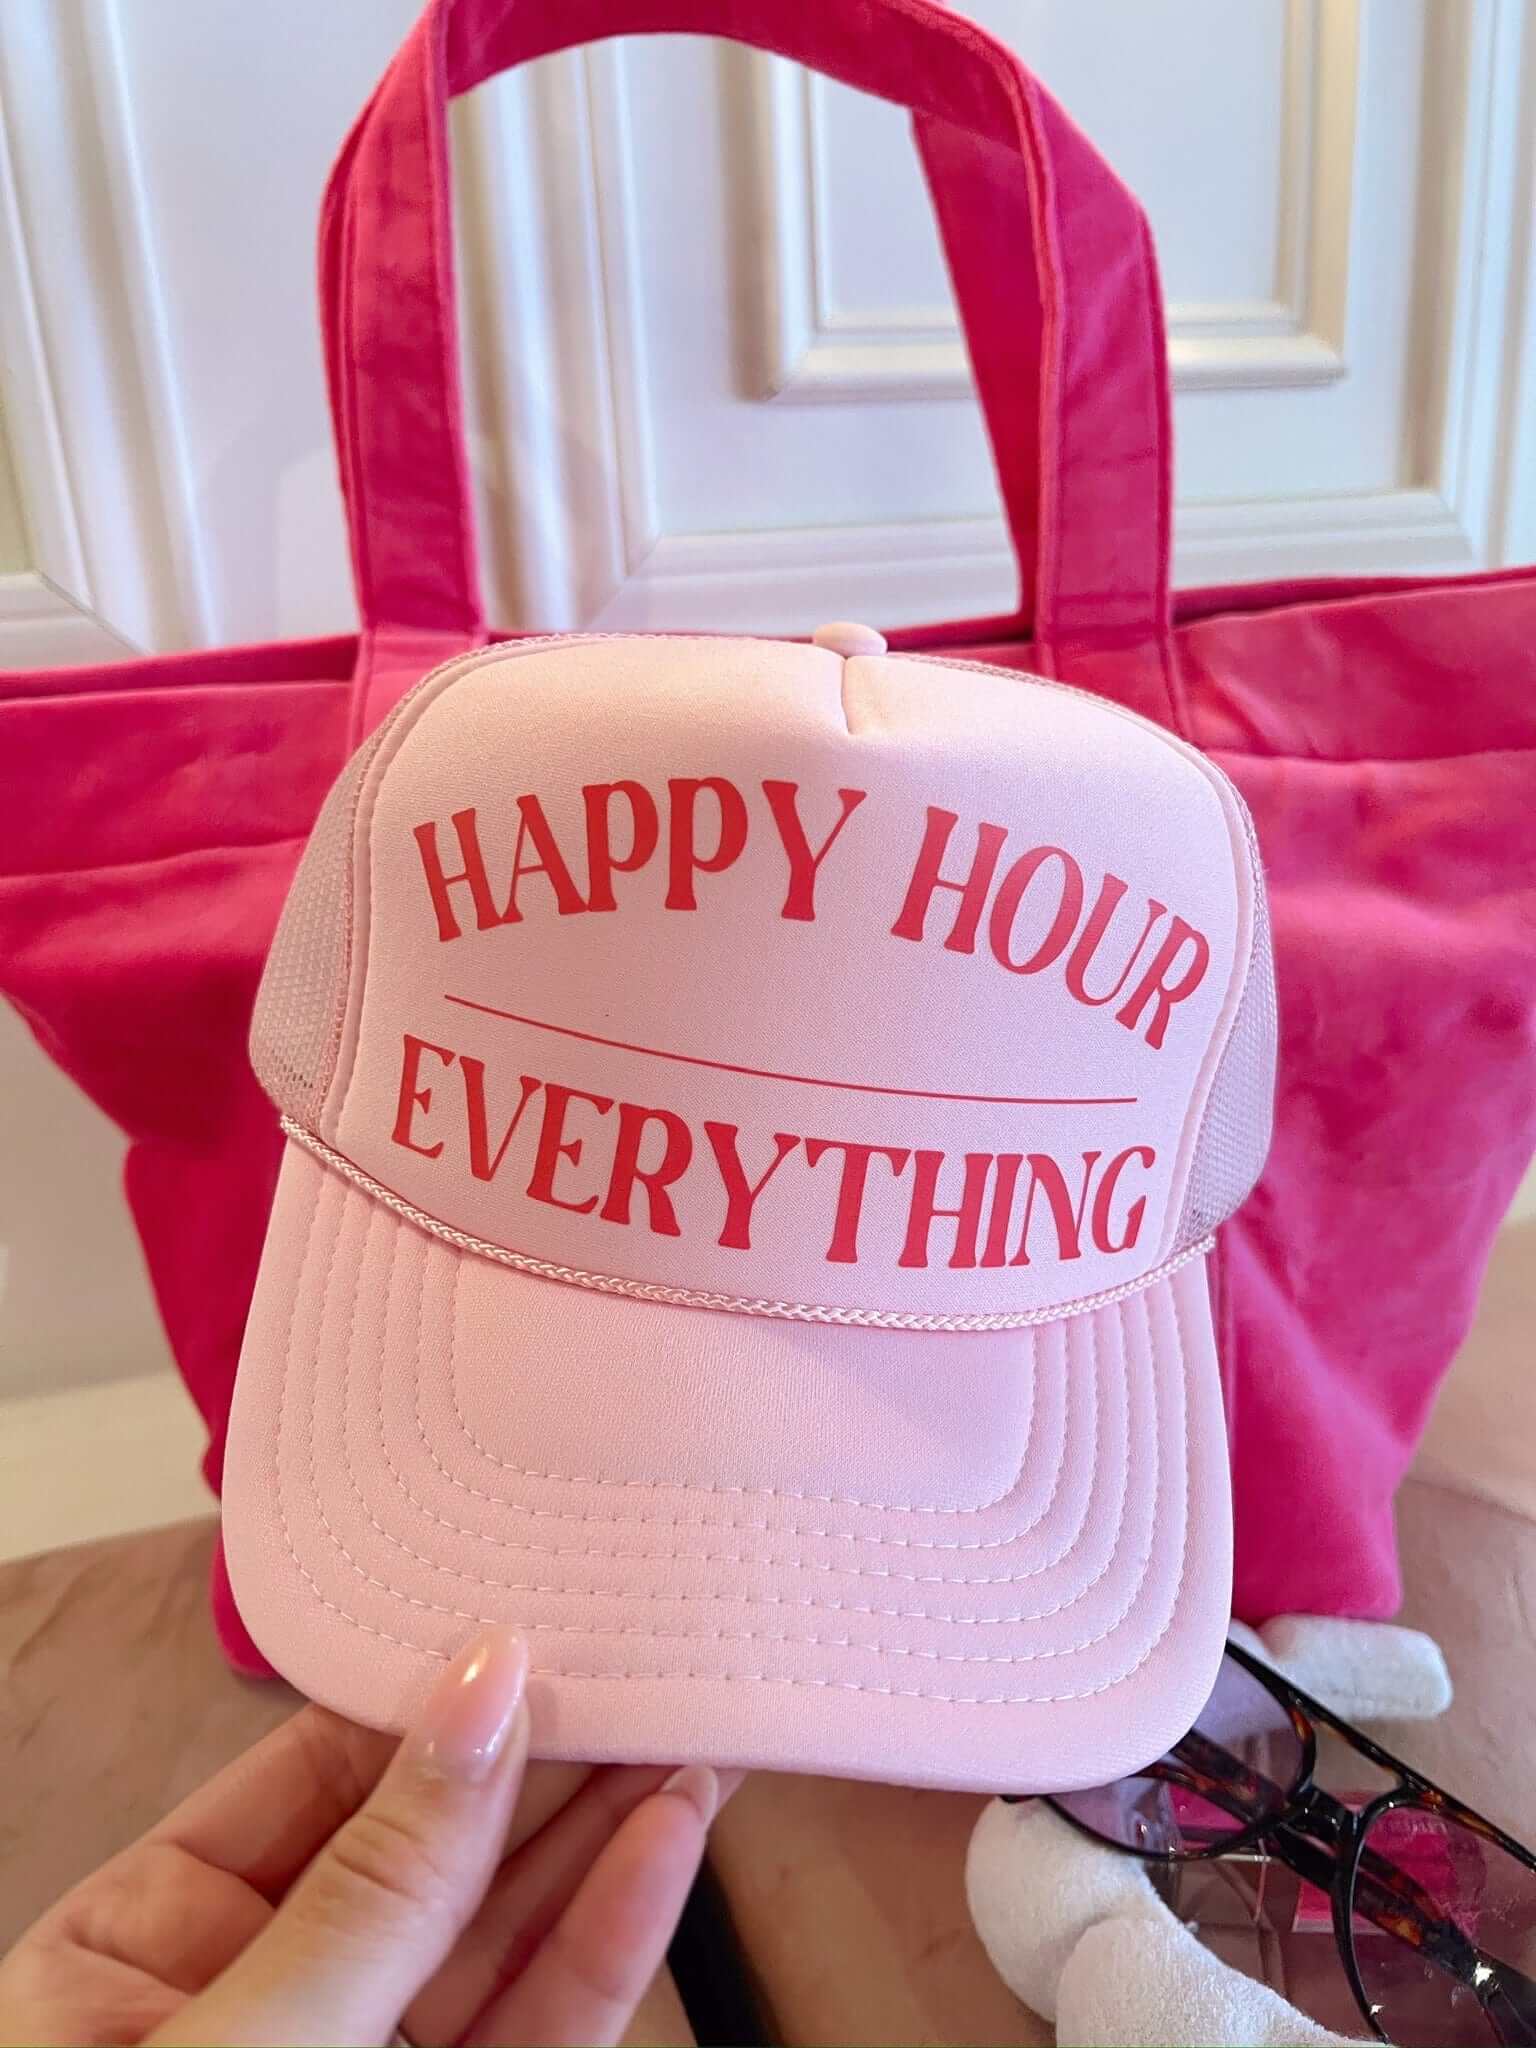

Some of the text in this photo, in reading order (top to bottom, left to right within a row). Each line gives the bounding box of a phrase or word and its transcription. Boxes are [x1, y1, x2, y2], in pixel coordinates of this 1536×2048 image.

[413, 777, 1211, 1050] HAPPY HOUR
[391, 1034, 1156, 1269] EVERYTHING
